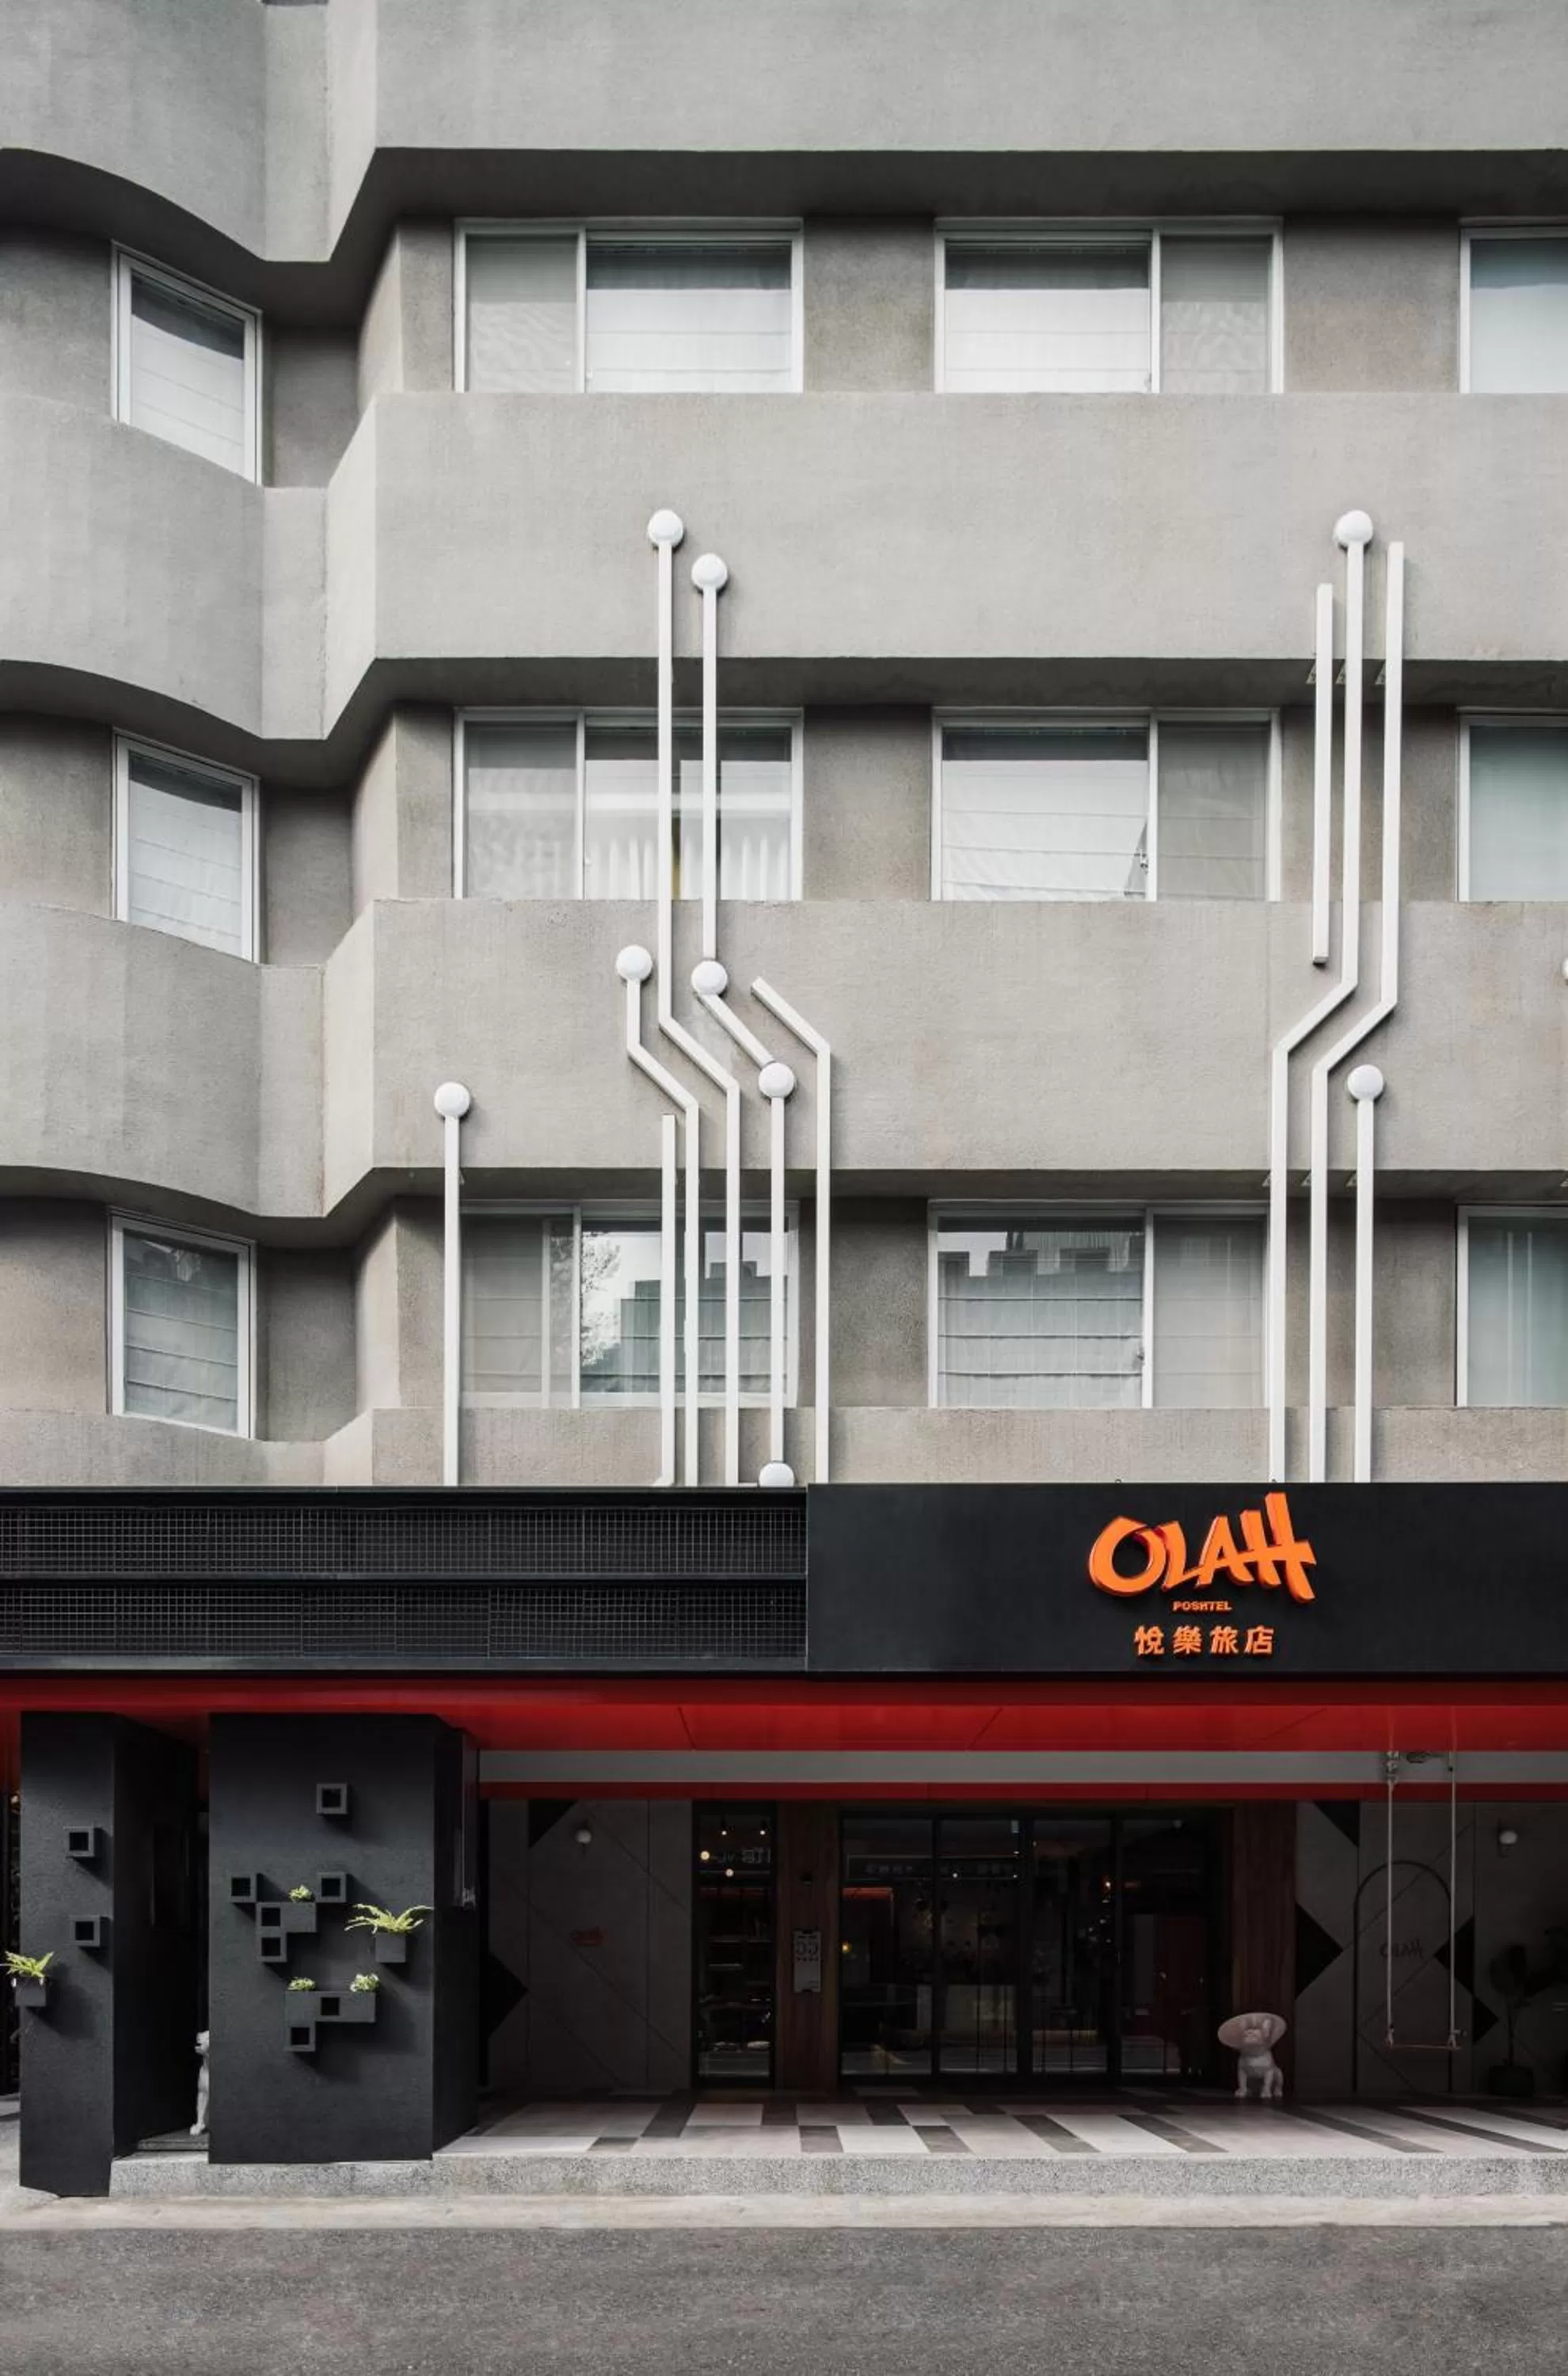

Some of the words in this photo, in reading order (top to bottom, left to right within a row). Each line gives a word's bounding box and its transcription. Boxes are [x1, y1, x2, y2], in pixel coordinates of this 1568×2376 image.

[1088, 1491, 1316, 1603] OLAH
[1172, 1601, 1232, 1611] POSHTEL
[1134, 1625, 1273, 1655] 悅樂旅店
